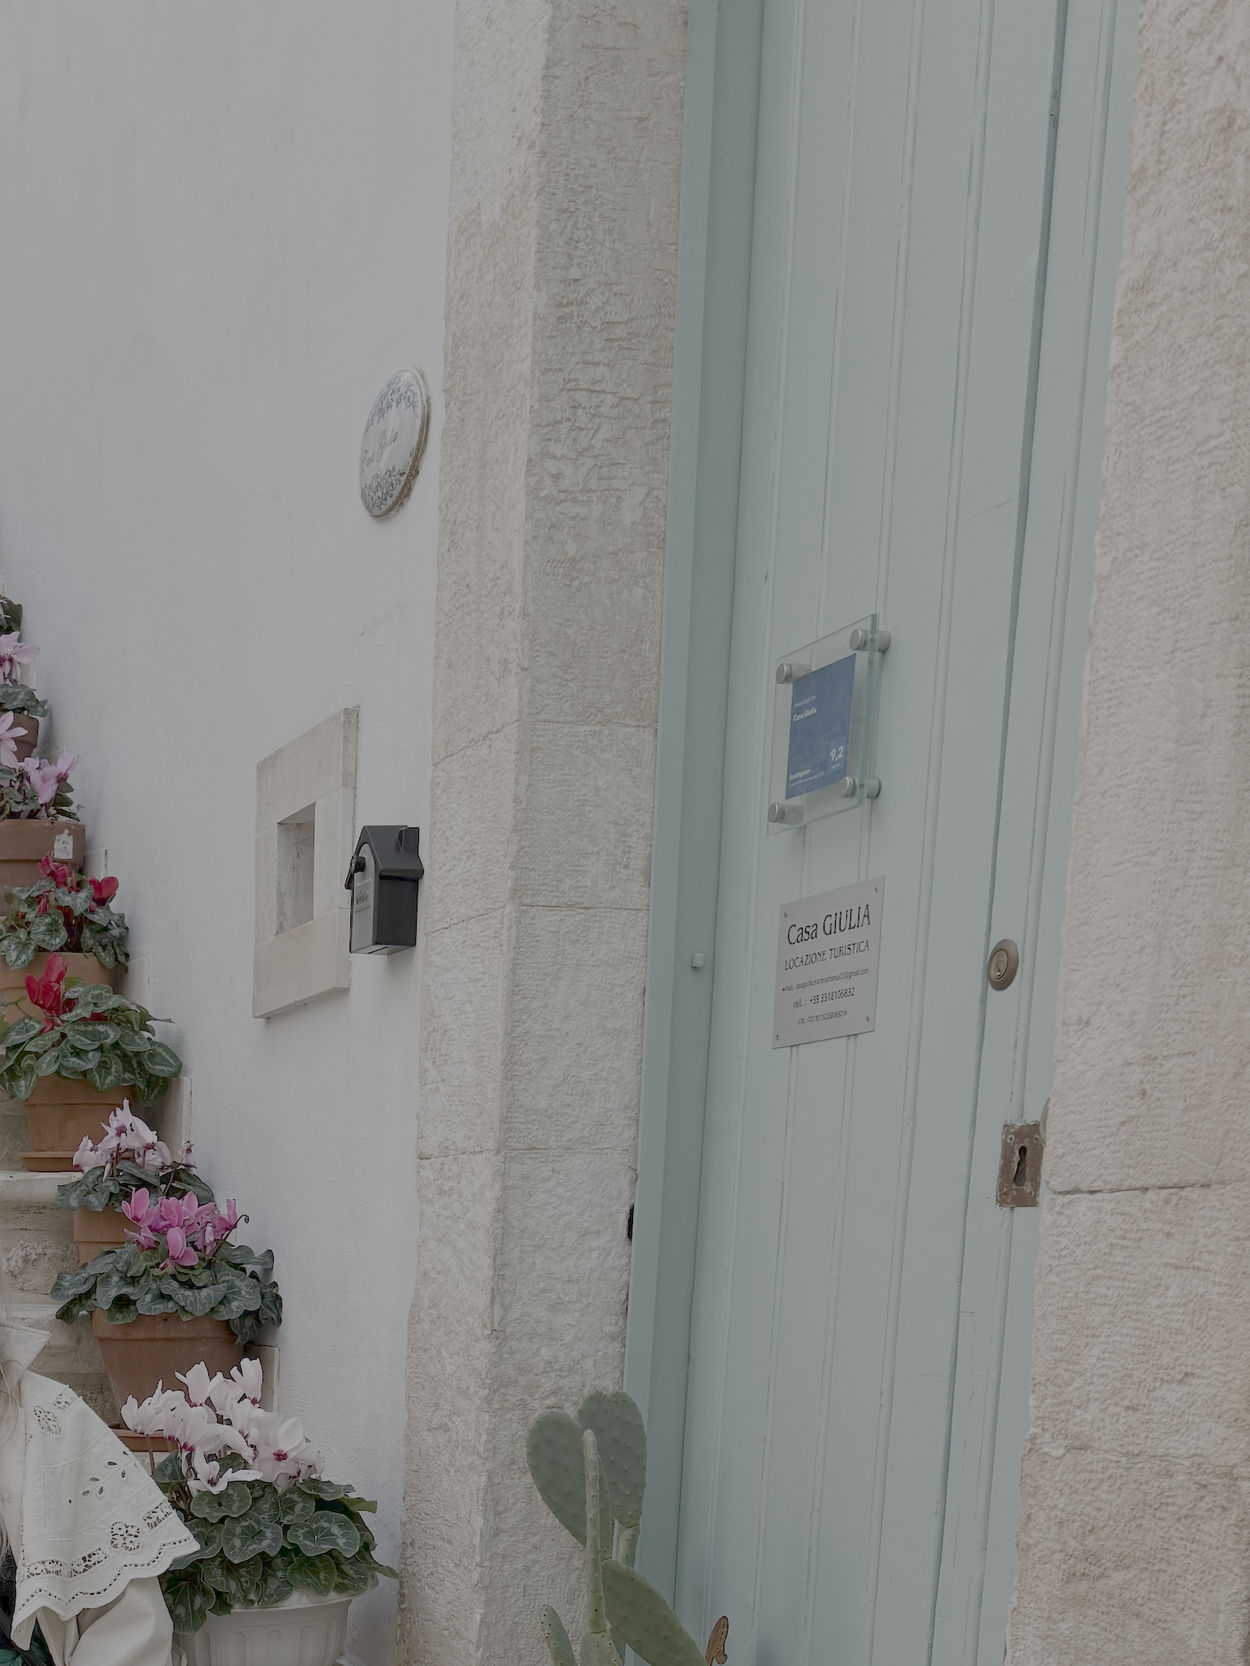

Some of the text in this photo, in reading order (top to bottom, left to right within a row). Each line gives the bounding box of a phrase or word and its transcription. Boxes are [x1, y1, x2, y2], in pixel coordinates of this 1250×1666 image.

[830, 745, 844, 762] 9,2
[787, 904, 871, 945] Casa GIULIA
[784, 940, 870, 971] LOCAZIONE TURISTICA
